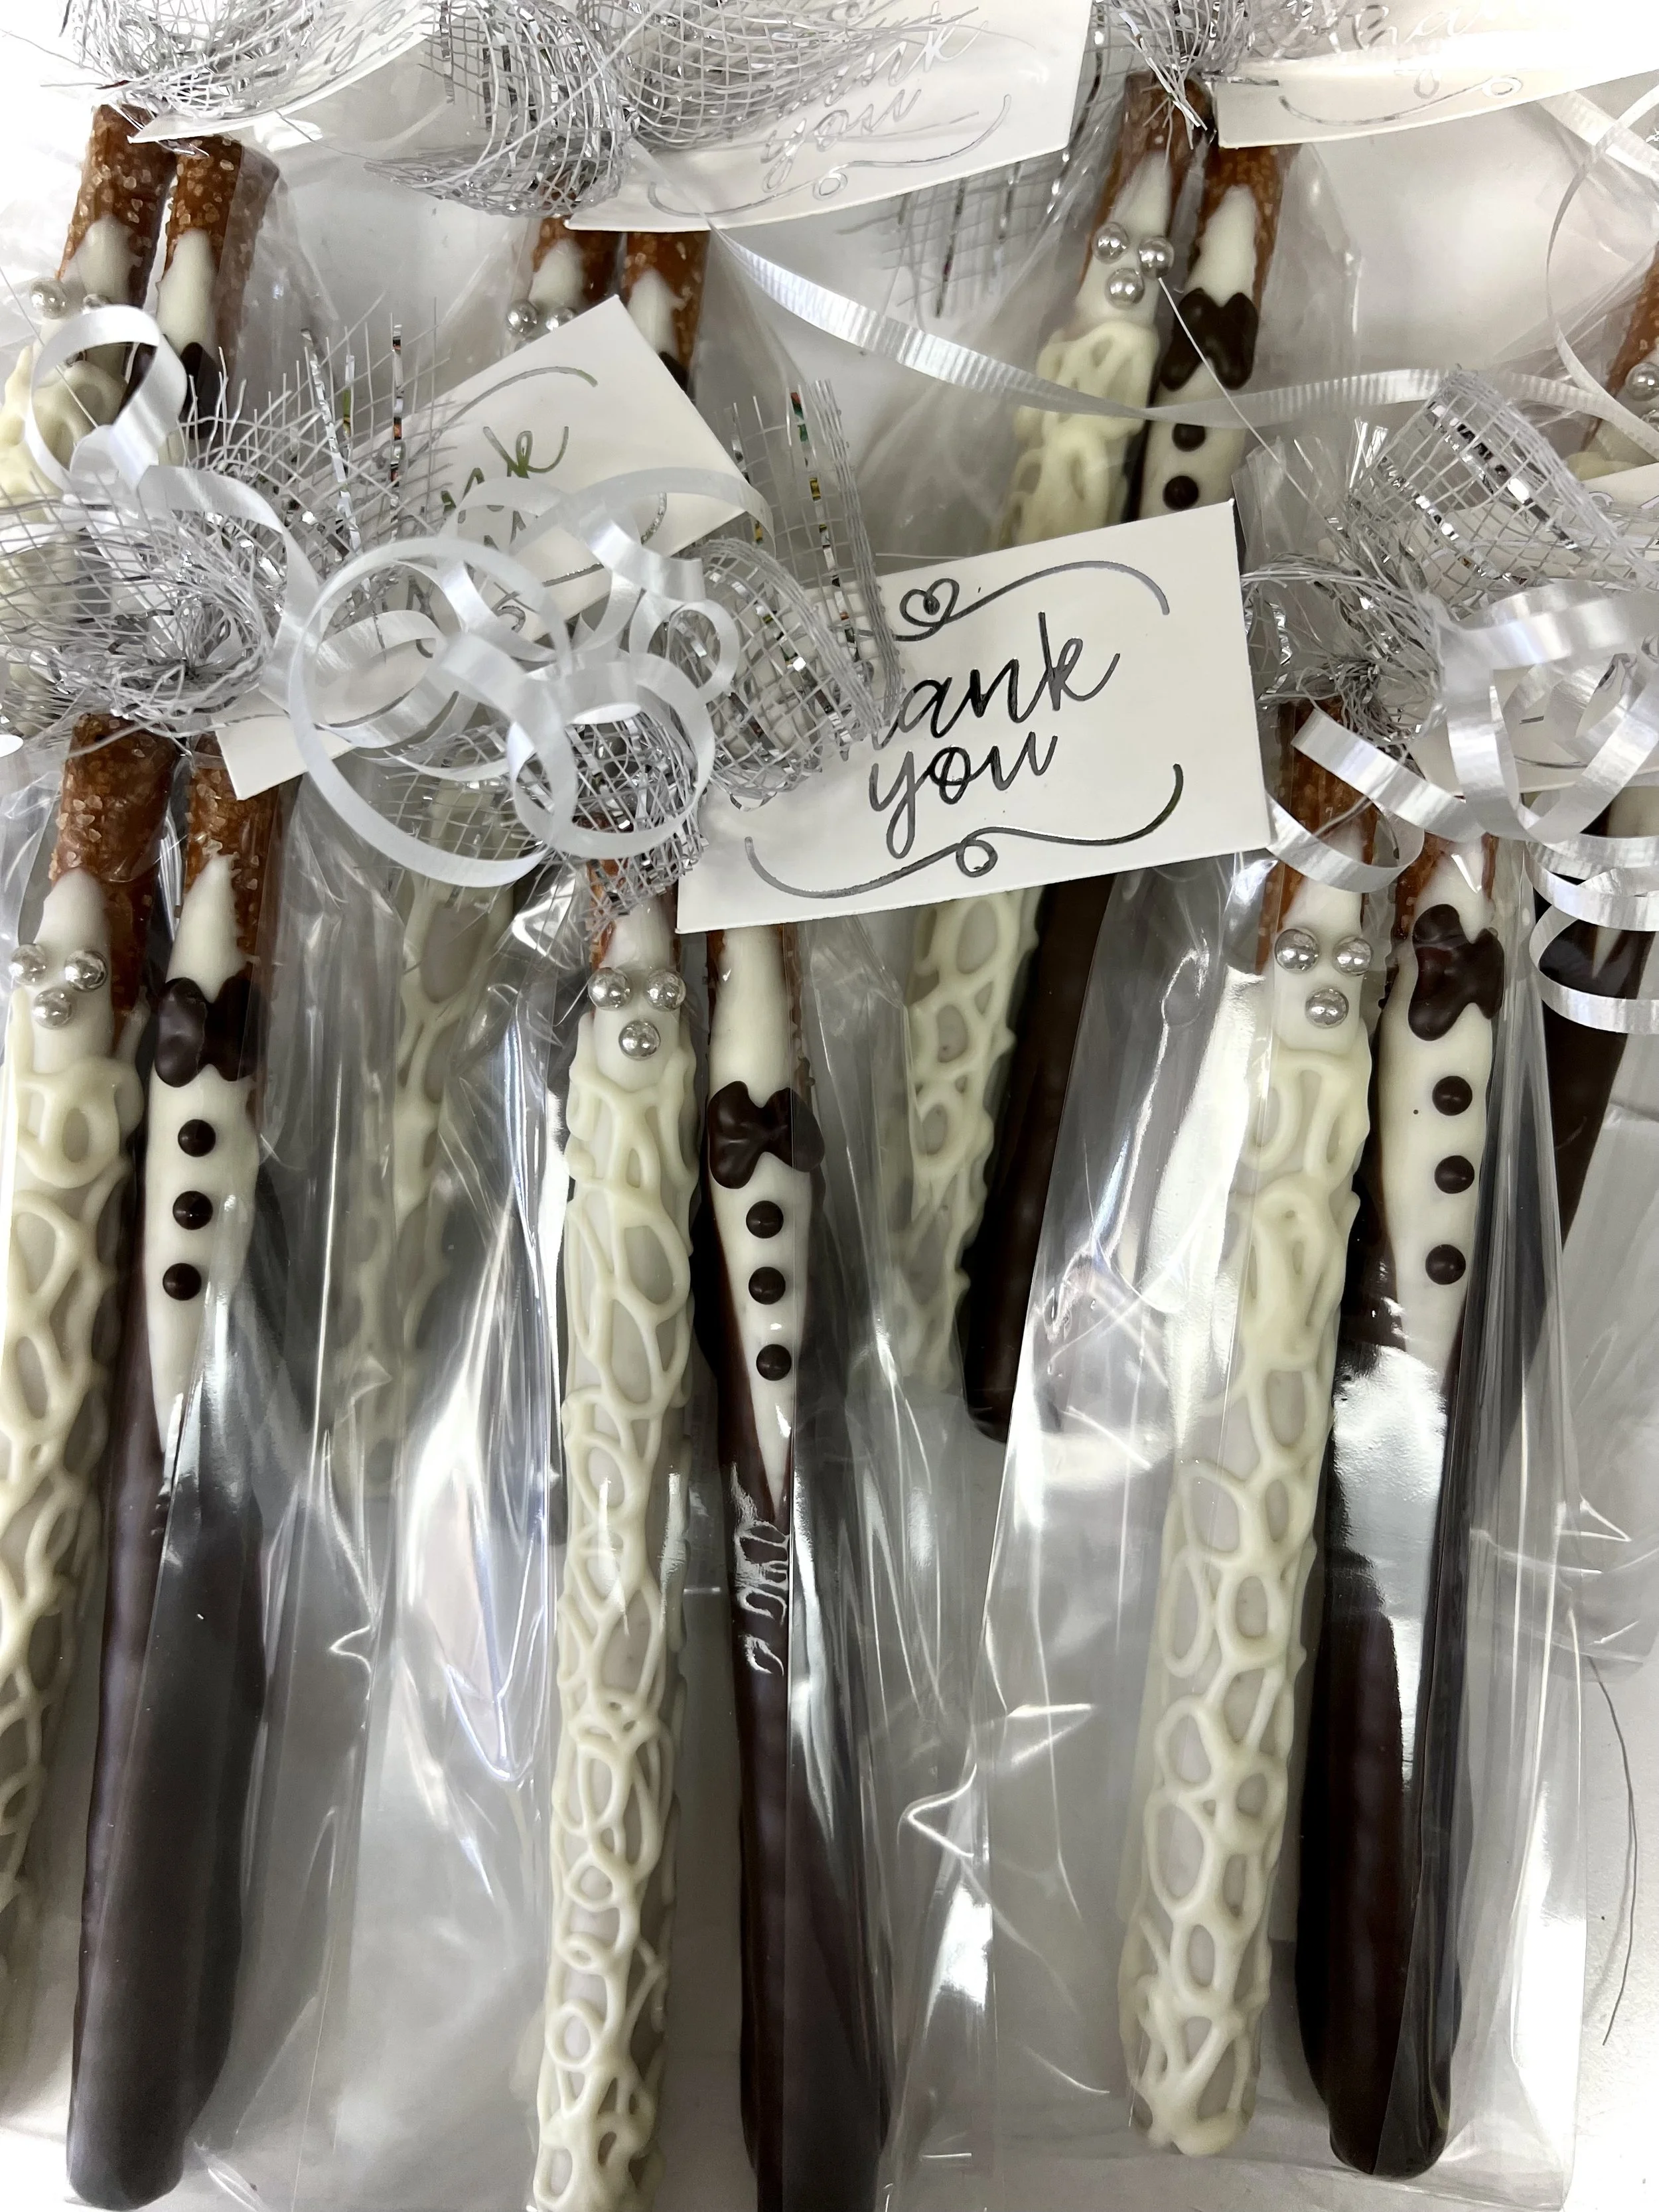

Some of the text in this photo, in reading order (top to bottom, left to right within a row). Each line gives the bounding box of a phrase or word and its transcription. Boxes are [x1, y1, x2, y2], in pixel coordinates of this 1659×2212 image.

[760, 89, 922, 193] you
[872, 611, 1121, 750] ank
[869, 731, 1058, 859] you
